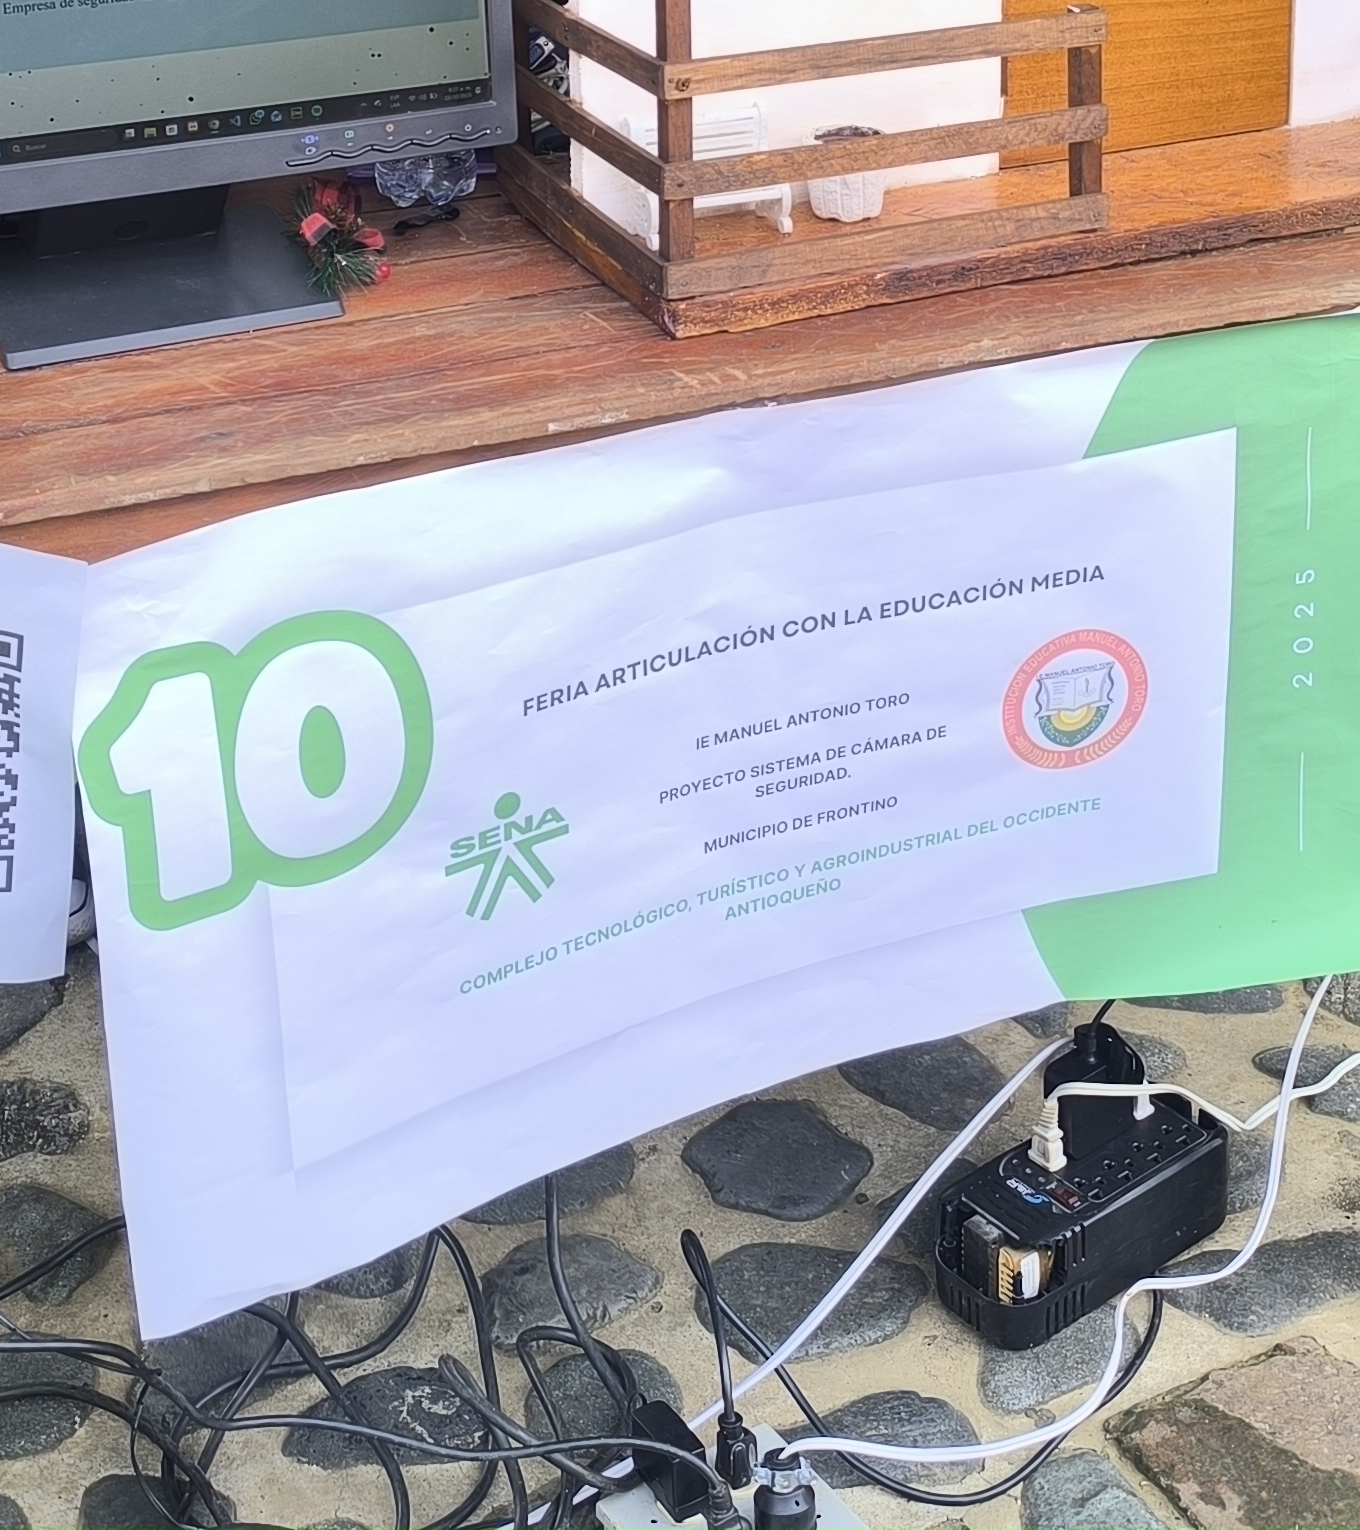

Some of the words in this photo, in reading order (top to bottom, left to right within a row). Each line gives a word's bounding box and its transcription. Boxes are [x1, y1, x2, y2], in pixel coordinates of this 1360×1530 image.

[3, 1, 56, 16] Empresa
[522, 680, 589, 717] FERIA
[594, 625, 775, 692] ARTICULACIÓN
[782, 611, 836, 638] CON
[844, 606, 872, 626] LA
[880, 578, 1023, 620] EDUCACIÓN
[1030, 565, 1104, 592] MEDIA
[1004, 672, 1027, 737] INSTITUCION
[1024, 635, 1077, 672] EDUCATIVA
[1079, 631, 1118, 649] MANUEL
[1116, 645, 1144, 683] ANTONIO
[1131, 684, 1146, 712] TORO
[696, 736, 710, 750] IE
[714, 719, 782, 746] MANUEL
[786, 702, 861, 729] ANTONIO
[865, 693, 910, 712] TORO
[77, 609, 435, 931] 10
[659, 769, 746, 804] PROYECTO
[751, 752, 821, 778] SISTEMA
[826, 746, 846, 761] DE
[851, 737, 922, 756] CÁMARA
[926, 725, 947, 741] DE
[755, 767, 852, 798] SEGURIDAD.
[449, 806, 566, 860] SENA
[704, 821, 788, 854] MUNICIPIO
[792, 815, 813, 831] DE
[817, 796, 898, 825] FRONTINO
[459, 946, 558, 995] COMPLEJO
[562, 898, 692, 956] TECNOLÓGICO,
[696, 868, 790, 906] TURÍSTICO
[795, 864, 806, 878] Y
[811, 827, 963, 875] AGROINDUSTRIAL
[967, 820, 998, 838] DEL
[1003, 798, 1101, 829] OCCIDENTE
[724, 878, 841, 920] ANTIOQUEÑO
